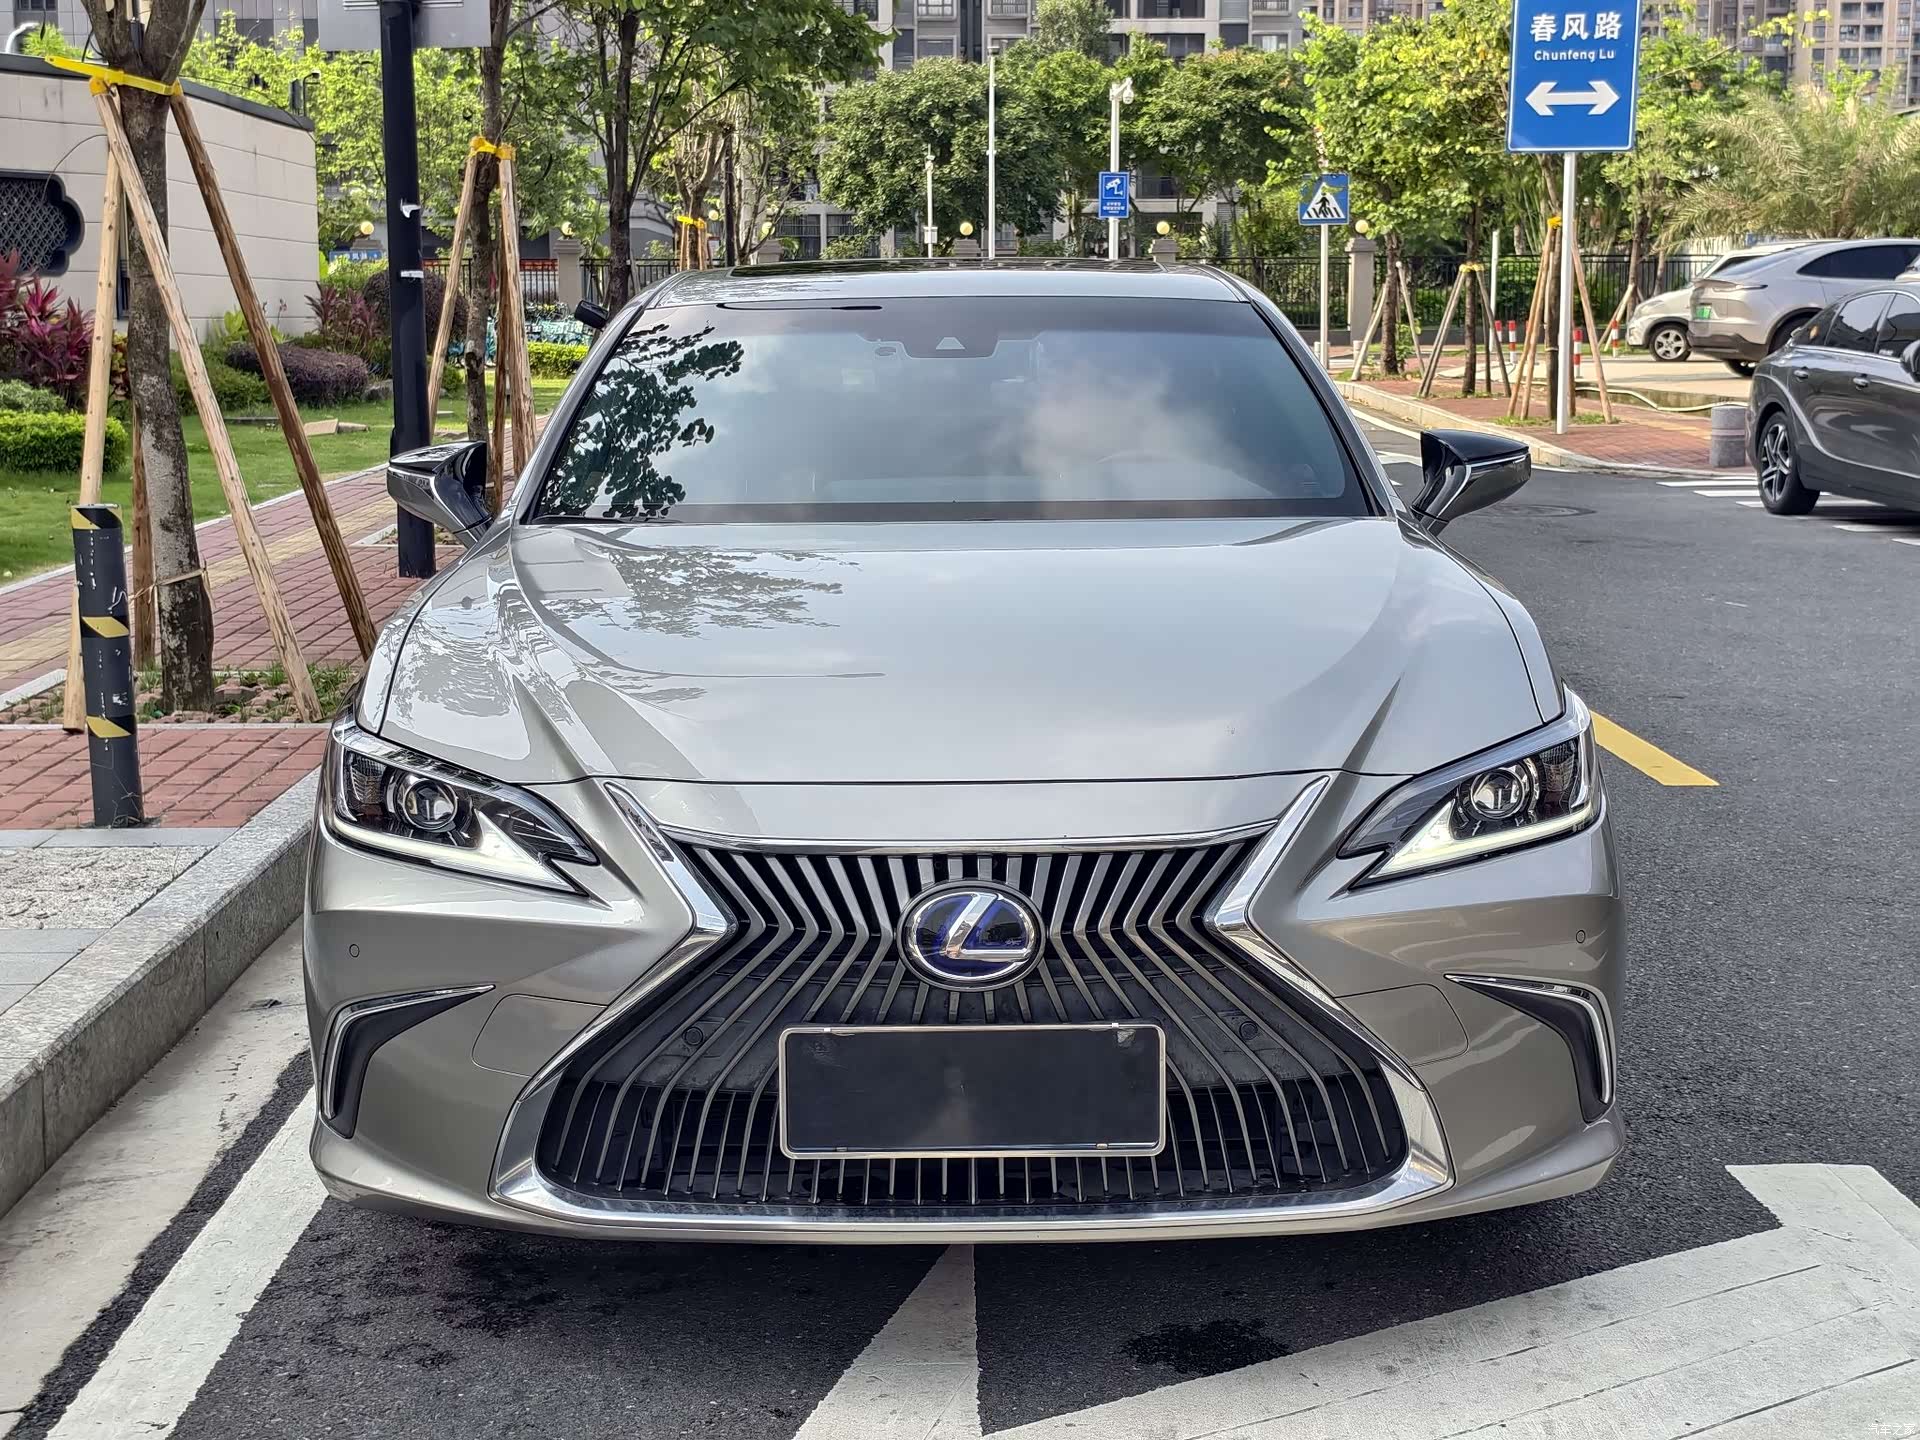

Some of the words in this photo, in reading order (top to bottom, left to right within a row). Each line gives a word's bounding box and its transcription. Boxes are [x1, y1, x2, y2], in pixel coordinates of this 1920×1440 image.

[1530, 11, 1622, 42] 春风路
[1534, 50, 1595, 62] Chunfeng
[1599, 49, 1615, 59] Lu
